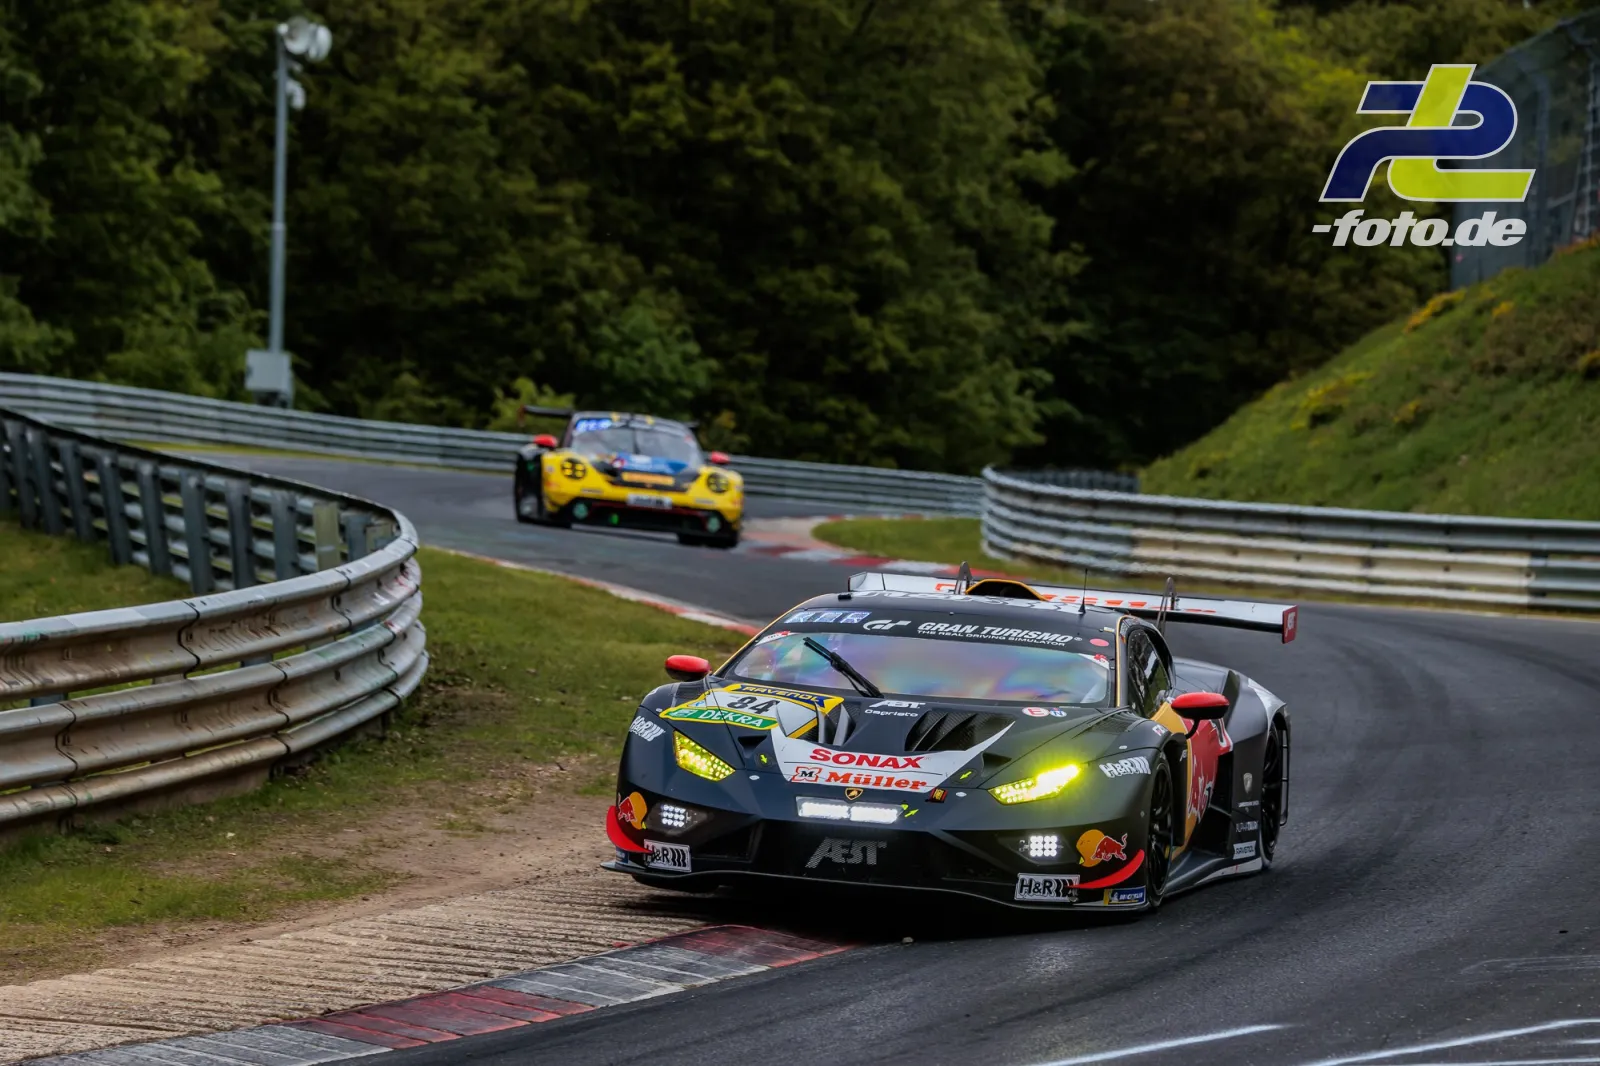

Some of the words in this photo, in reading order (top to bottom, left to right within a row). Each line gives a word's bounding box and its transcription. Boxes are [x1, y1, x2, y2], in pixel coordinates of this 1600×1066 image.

[917, 622, 979, 634] GRAN
[965, 633, 1006, 641] DRIVING
[1008, 636, 1066, 647] SIMULATOR
[743, 685, 820, 703] RAVENOL
[726, 696, 780, 715] 84
[864, 708, 919, 717] Capristo
[698, 709, 764, 727] DEKRA
[809, 748, 925, 769] SONAX
[1099, 757, 1138, 778] H&R
[825, 771, 927, 790] Müller
